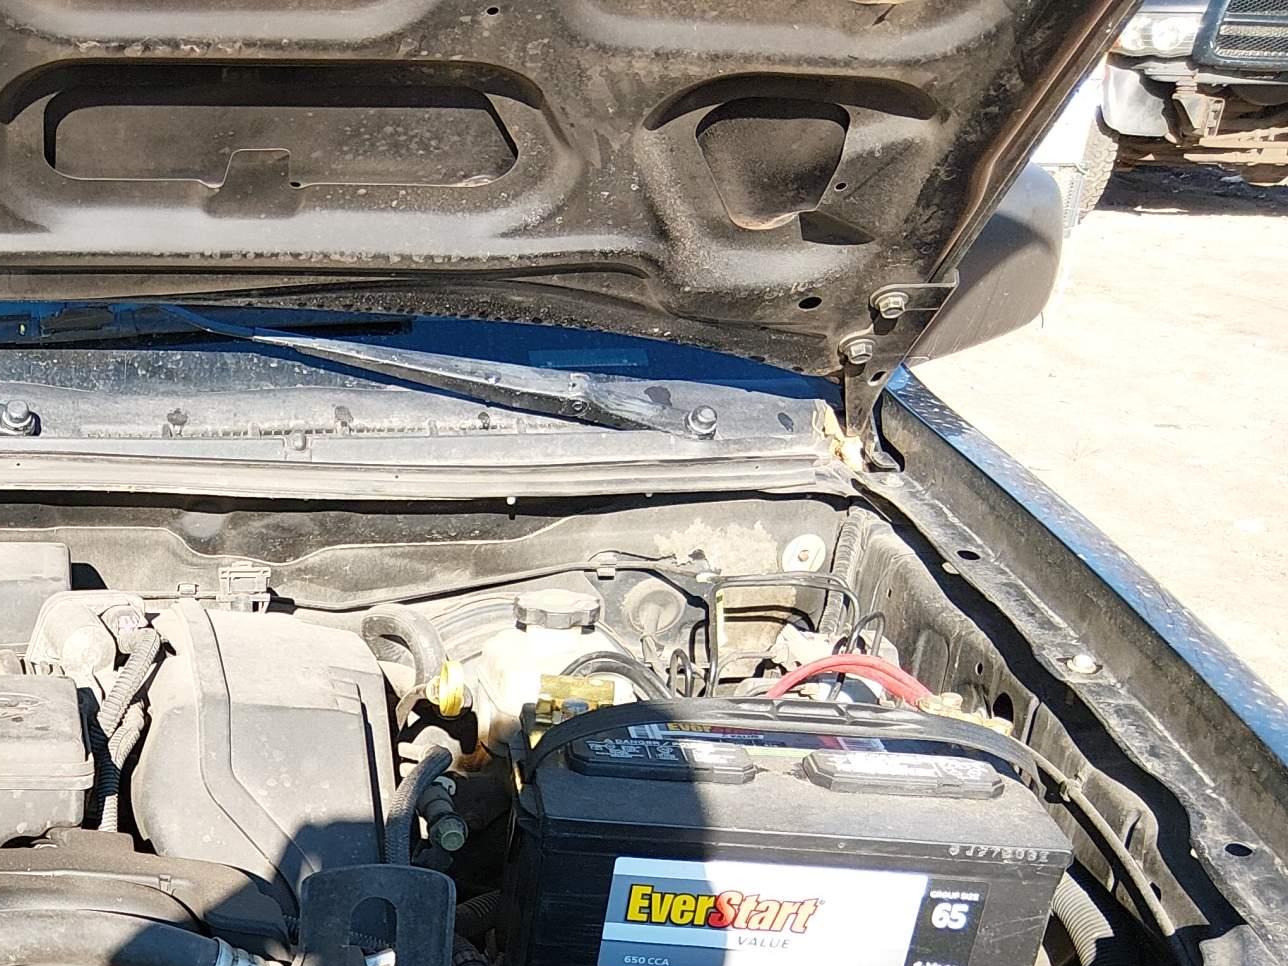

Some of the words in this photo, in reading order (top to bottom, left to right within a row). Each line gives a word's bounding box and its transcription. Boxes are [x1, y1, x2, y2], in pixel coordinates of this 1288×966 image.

[625, 884, 820, 934] EverStart
[932, 902, 969, 929] 65
[737, 936, 791, 949] VALUE
[624, 955, 646, 965] 650
[648, 957, 670, 966] CCA
